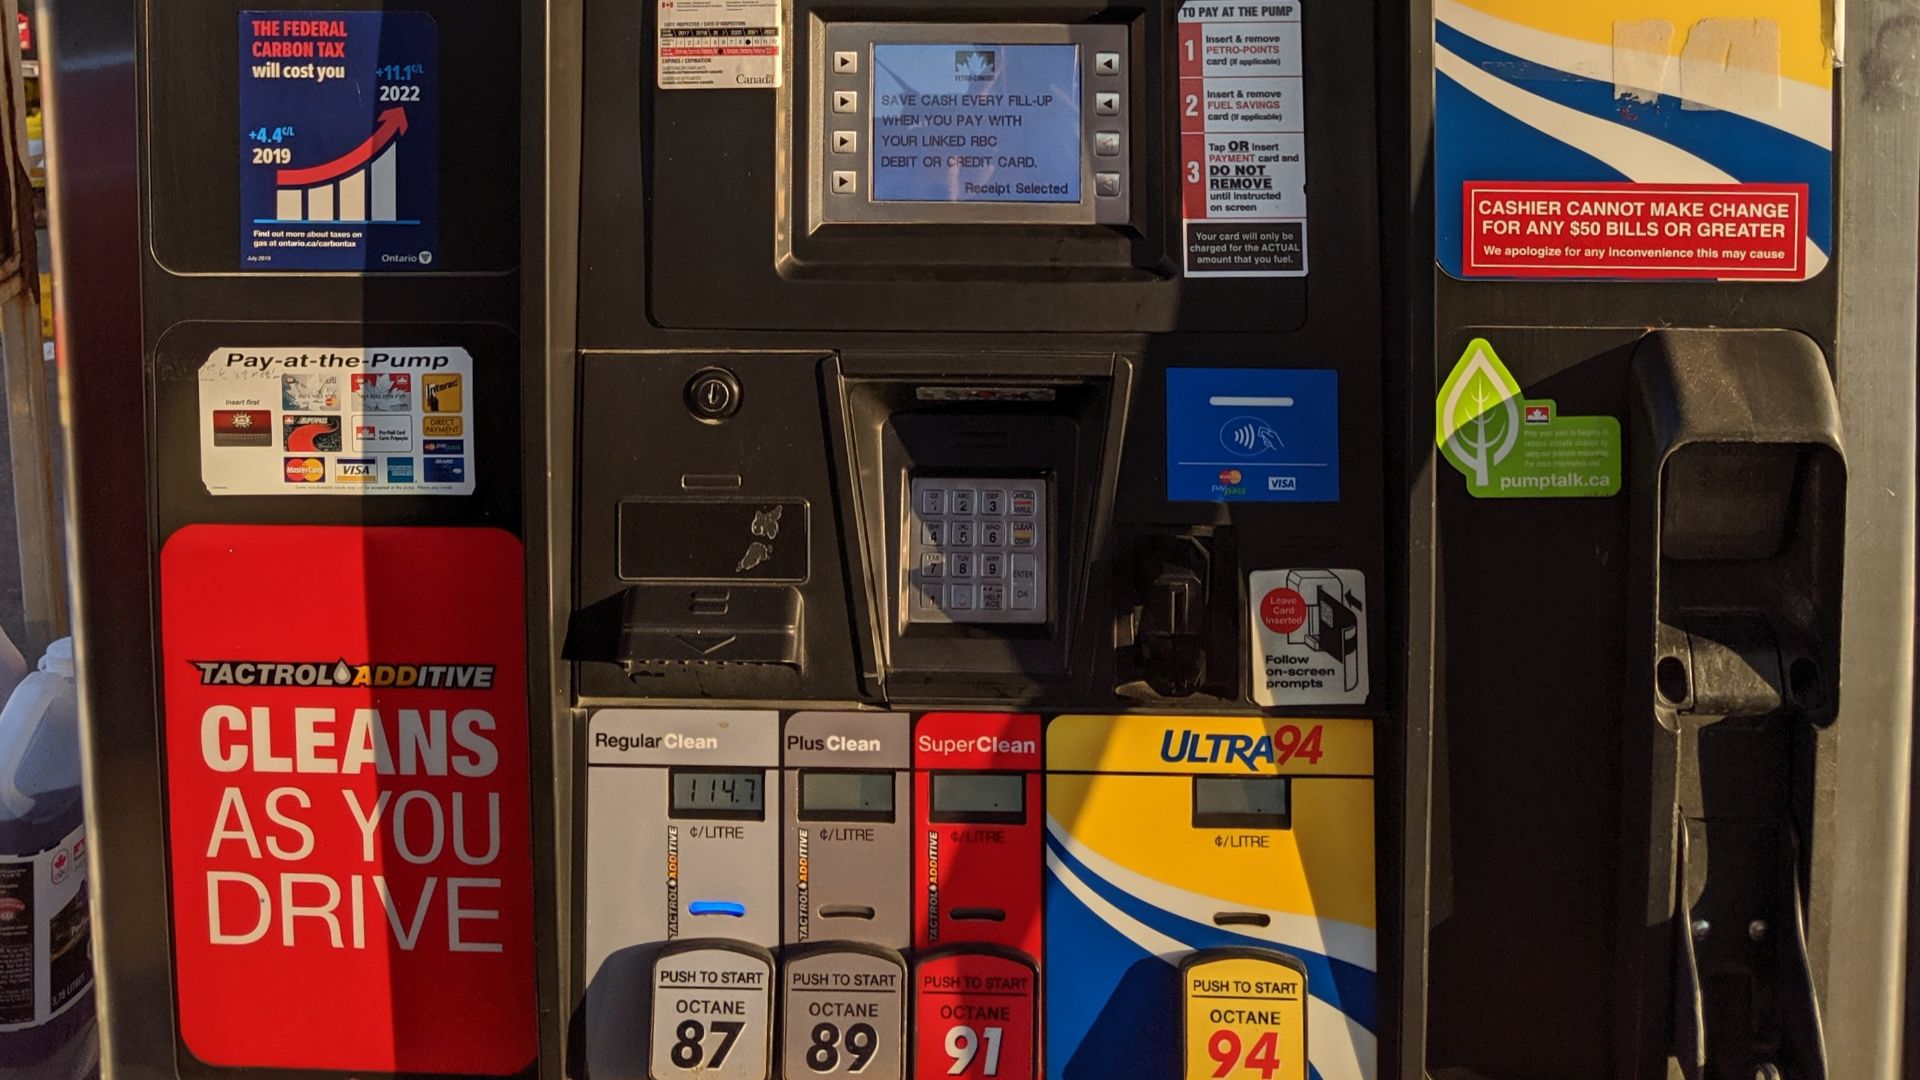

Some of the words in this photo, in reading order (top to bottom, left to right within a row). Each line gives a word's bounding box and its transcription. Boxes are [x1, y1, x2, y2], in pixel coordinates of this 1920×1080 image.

[1183, 7, 1195, 17] TO
[1200, 7, 1218, 17] PAY
[1222, 7, 1235, 17] AT
[1238, 7, 1258, 16] THE
[1262, 6, 1293, 16] PUMP
[252, 21, 279, 36] THE
[283, 21, 347, 37] FEDERAL
[1206, 35, 1232, 43] Insert
[252, 42, 313, 57] CARBON
[317, 42, 345, 58] TAX
[1185, 40, 1194, 61] 1
[1206, 46, 1280, 54] PETRO-POINTS
[1240, 58, 1281, 66] applicable)
[252, 62, 279, 78] will
[283, 63, 314, 78] cost
[317, 66, 344, 82] you
[736, 74, 774, 84] Canada
[380, 86, 420, 101] 2022
[882, 95, 916, 106] SAVE
[921, 95, 957, 106] CASH
[962, 95, 1004, 106] EVERY
[1008, 95, 1053, 106] FILL-UP
[1185, 95, 1198, 116] 2
[1208, 101, 1233, 109] FUEL
[1236, 101, 1280, 109] SAVINGS
[882, 115, 920, 126] WHEN
[925, 115, 951, 126] YOU
[957, 115, 983, 126] PAY
[988, 115, 1022, 126] WITH
[1241, 113, 1282, 121] applicable)
[882, 136, 918, 147] YOUR
[922, 136, 965, 147] LINKED
[970, 136, 997, 147] RBC
[1208, 143, 1226, 153] Tap
[1228, 141, 1249, 152] OR
[253, 148, 291, 164] 2019
[881, 157, 917, 168] DEBIT
[923, 157, 942, 168] OR
[947, 157, 992, 168] CREDIT
[998, 157, 1037, 168] CARD.
[1209, 154, 1255, 162] PAYMENT
[1258, 154, 1279, 162] card
[1281, 154, 1299, 162] and
[1187, 161, 1200, 183] 3
[1210, 165, 1230, 176] DO
[1235, 165, 1266, 176] NOT
[965, 183, 1011, 195] Receipt
[1016, 183, 1068, 194] Selected
[1210, 178, 1272, 190] REMOVE
[1210, 192, 1230, 200] until
[1234, 192, 1281, 200] instructed
[1479, 200, 1562, 216] CASHIER
[1567, 201, 1645, 217] CANNOT
[1650, 202, 1704, 217] MAKE
[1709, 203, 1790, 218] CHANGE
[254, 230, 270, 238] Find
[1482, 221, 1521, 235] FOR
[1526, 221, 1565, 236] ANY
[1570, 221, 1601, 237] $50
[1606, 222, 1659, 236] BILLS
[1664, 222, 1691, 237] OR
[1697, 223, 1785, 238] GREATER
[1196, 232, 1217, 240] Your
[1219, 232, 1240, 240] card
[1242, 232, 1257, 240] will
[1260, 232, 1279, 241] only
[1282, 232, 1294, 240] be
[1190, 244, 1227, 253] charged
[1229, 244, 1242, 252] for
[1245, 244, 1259, 252] the
[1484, 246, 1502, 255] We
[1505, 246, 1562, 258] apologize
[1564, 245, 1580, 257] for
[1584, 248, 1606, 260] any
[1609, 247, 1693, 258] inconvenience
[1697, 248, 1719, 258] this
[1722, 250, 1747, 260] may
[1750, 251, 1785, 259] cause
[381, 254, 417, 263] Ontario
[1234, 255, 1252, 263] that
[1254, 257, 1271, 265] you
[1274, 255, 1293, 263] fuel.
[227, 353, 449, 371] Pay-at-the-Pump
[427, 380, 458, 398] Interac
[287, 466, 322, 475] MasterCard
[343, 465, 370, 475] VISA
[1271, 479, 1295, 488] VISA
[1501, 473, 1610, 490] pumptalk.ca
[1017, 590, 1028, 598] OK
[1270, 597, 1297, 605] Leave
[1266, 655, 1309, 664] Follow
[198, 662, 332, 686] TACTROL
[352, 664, 494, 688] ADDITIVE
[1266, 668, 1335, 676] on-screen
[1267, 679, 1323, 690] prompts
[200, 705, 499, 777] CLEANS
[690, 779, 755, 803] 114.7
[206, 786, 315, 861] AS
[342, 790, 500, 866] YOU
[668, 826, 678, 879] ADDITIVE
[206, 870, 503, 953] DRIVE
[668, 886, 679, 941] TACTROL
[660, 971, 697, 984] PUSH
[700, 972, 717, 983] TO
[721, 971, 764, 984] START
[793, 973, 828, 986] PUSH
[833, 974, 850, 986] TO
[854, 974, 896, 987] START
[1193, 980, 1229, 992] PUSH
[1233, 981, 1251, 993] TO
[1255, 982, 1298, 994] START
[676, 1000, 745, 1015] OCTANE
[809, 1002, 878, 1017] OCTANE
[940, 1005, 1010, 1021] OCTANE
[1210, 1009, 1281, 1025] OCTANE
[670, 1020, 746, 1070] 87
[805, 1022, 880, 1073] 89
[944, 1025, 1003, 1076] 91
[1208, 1029, 1280, 1079] 94
